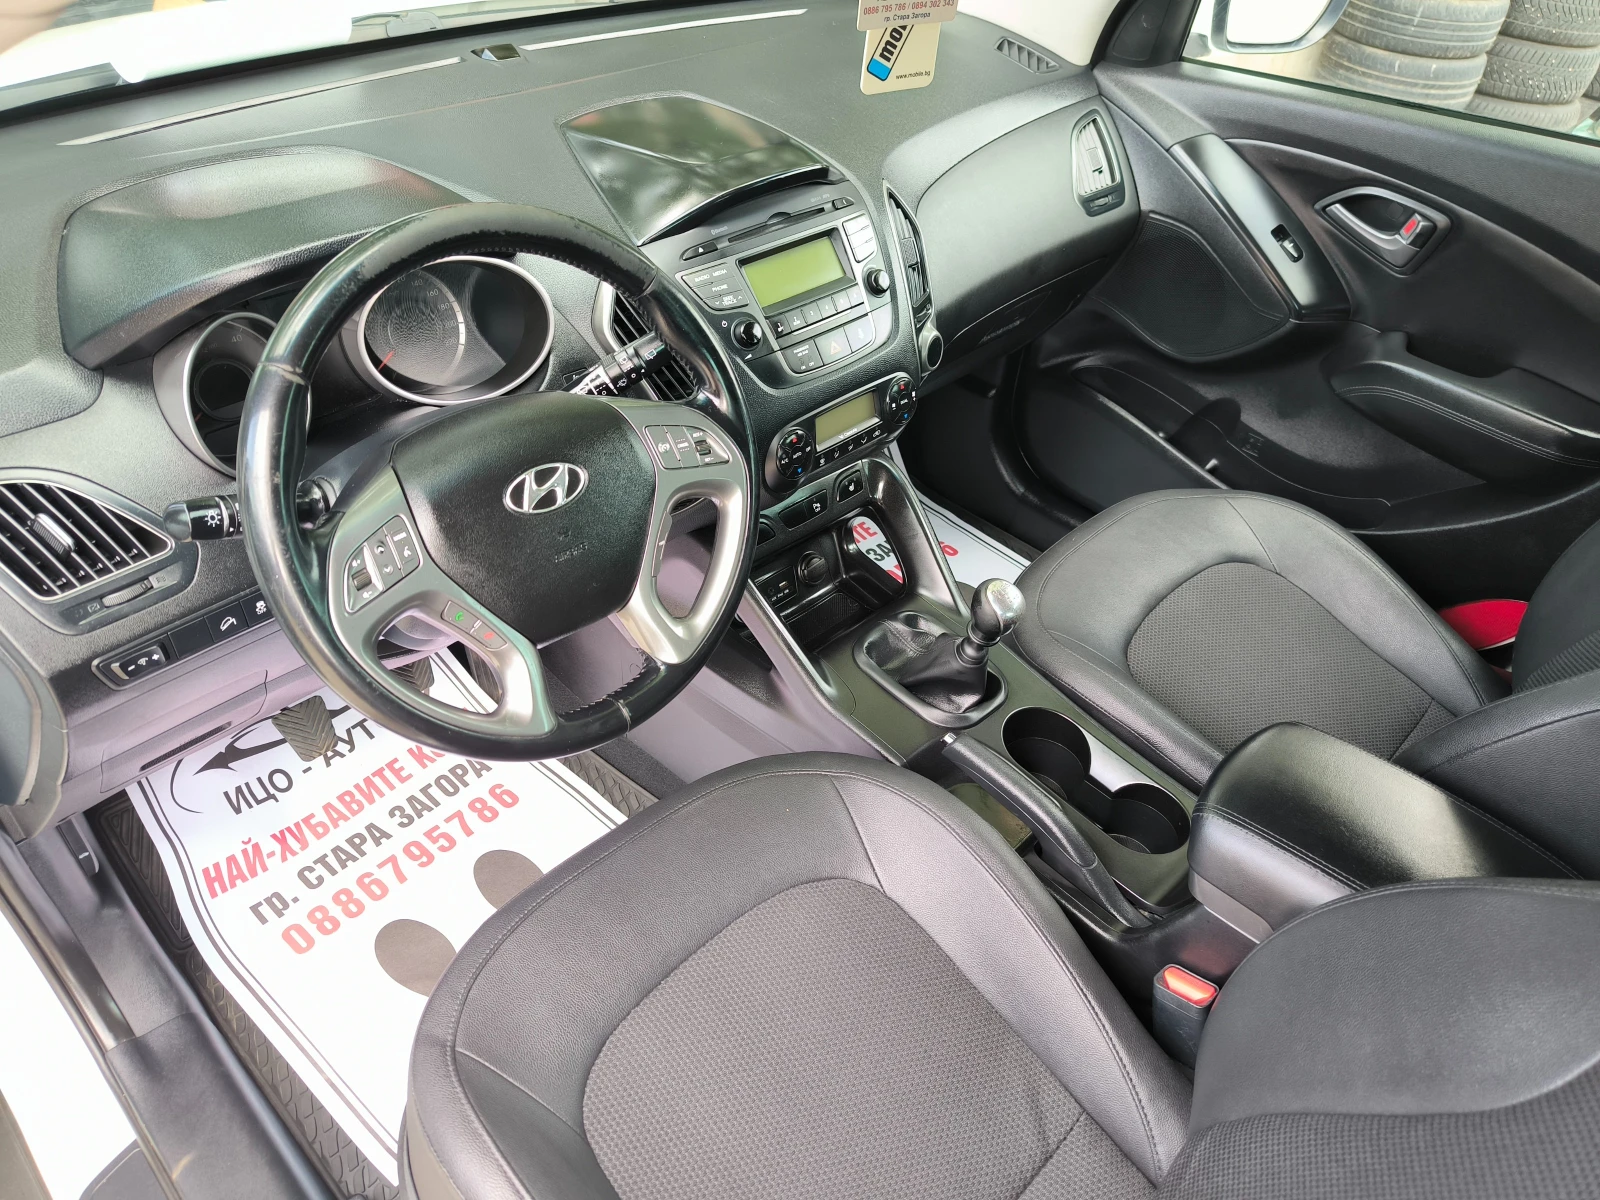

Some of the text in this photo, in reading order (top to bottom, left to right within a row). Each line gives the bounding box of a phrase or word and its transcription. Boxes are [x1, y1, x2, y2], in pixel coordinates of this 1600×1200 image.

[863, 6, 879, 16] 0886
[881, 4, 893, 13] 795
[894, 2, 906, 12] 786
[911, 0, 928, 10] 0894
[928, 0, 941, 8] 302
[892, 13, 910, 21] Стара
[896, 70, 931, 80] www.mobile.bg
[426, 288, 439, 297] 160
[438, 302, 450, 311] 180
[222, 767, 294, 816] ИЦО
[323, 717, 384, 768] АУТ
[201, 757, 414, 899] НАЙ-ХУБАВИТЕ
[248, 757, 493, 926] гр. СТАРА ЗАГОРА
[281, 783, 520, 955] 0886795786
